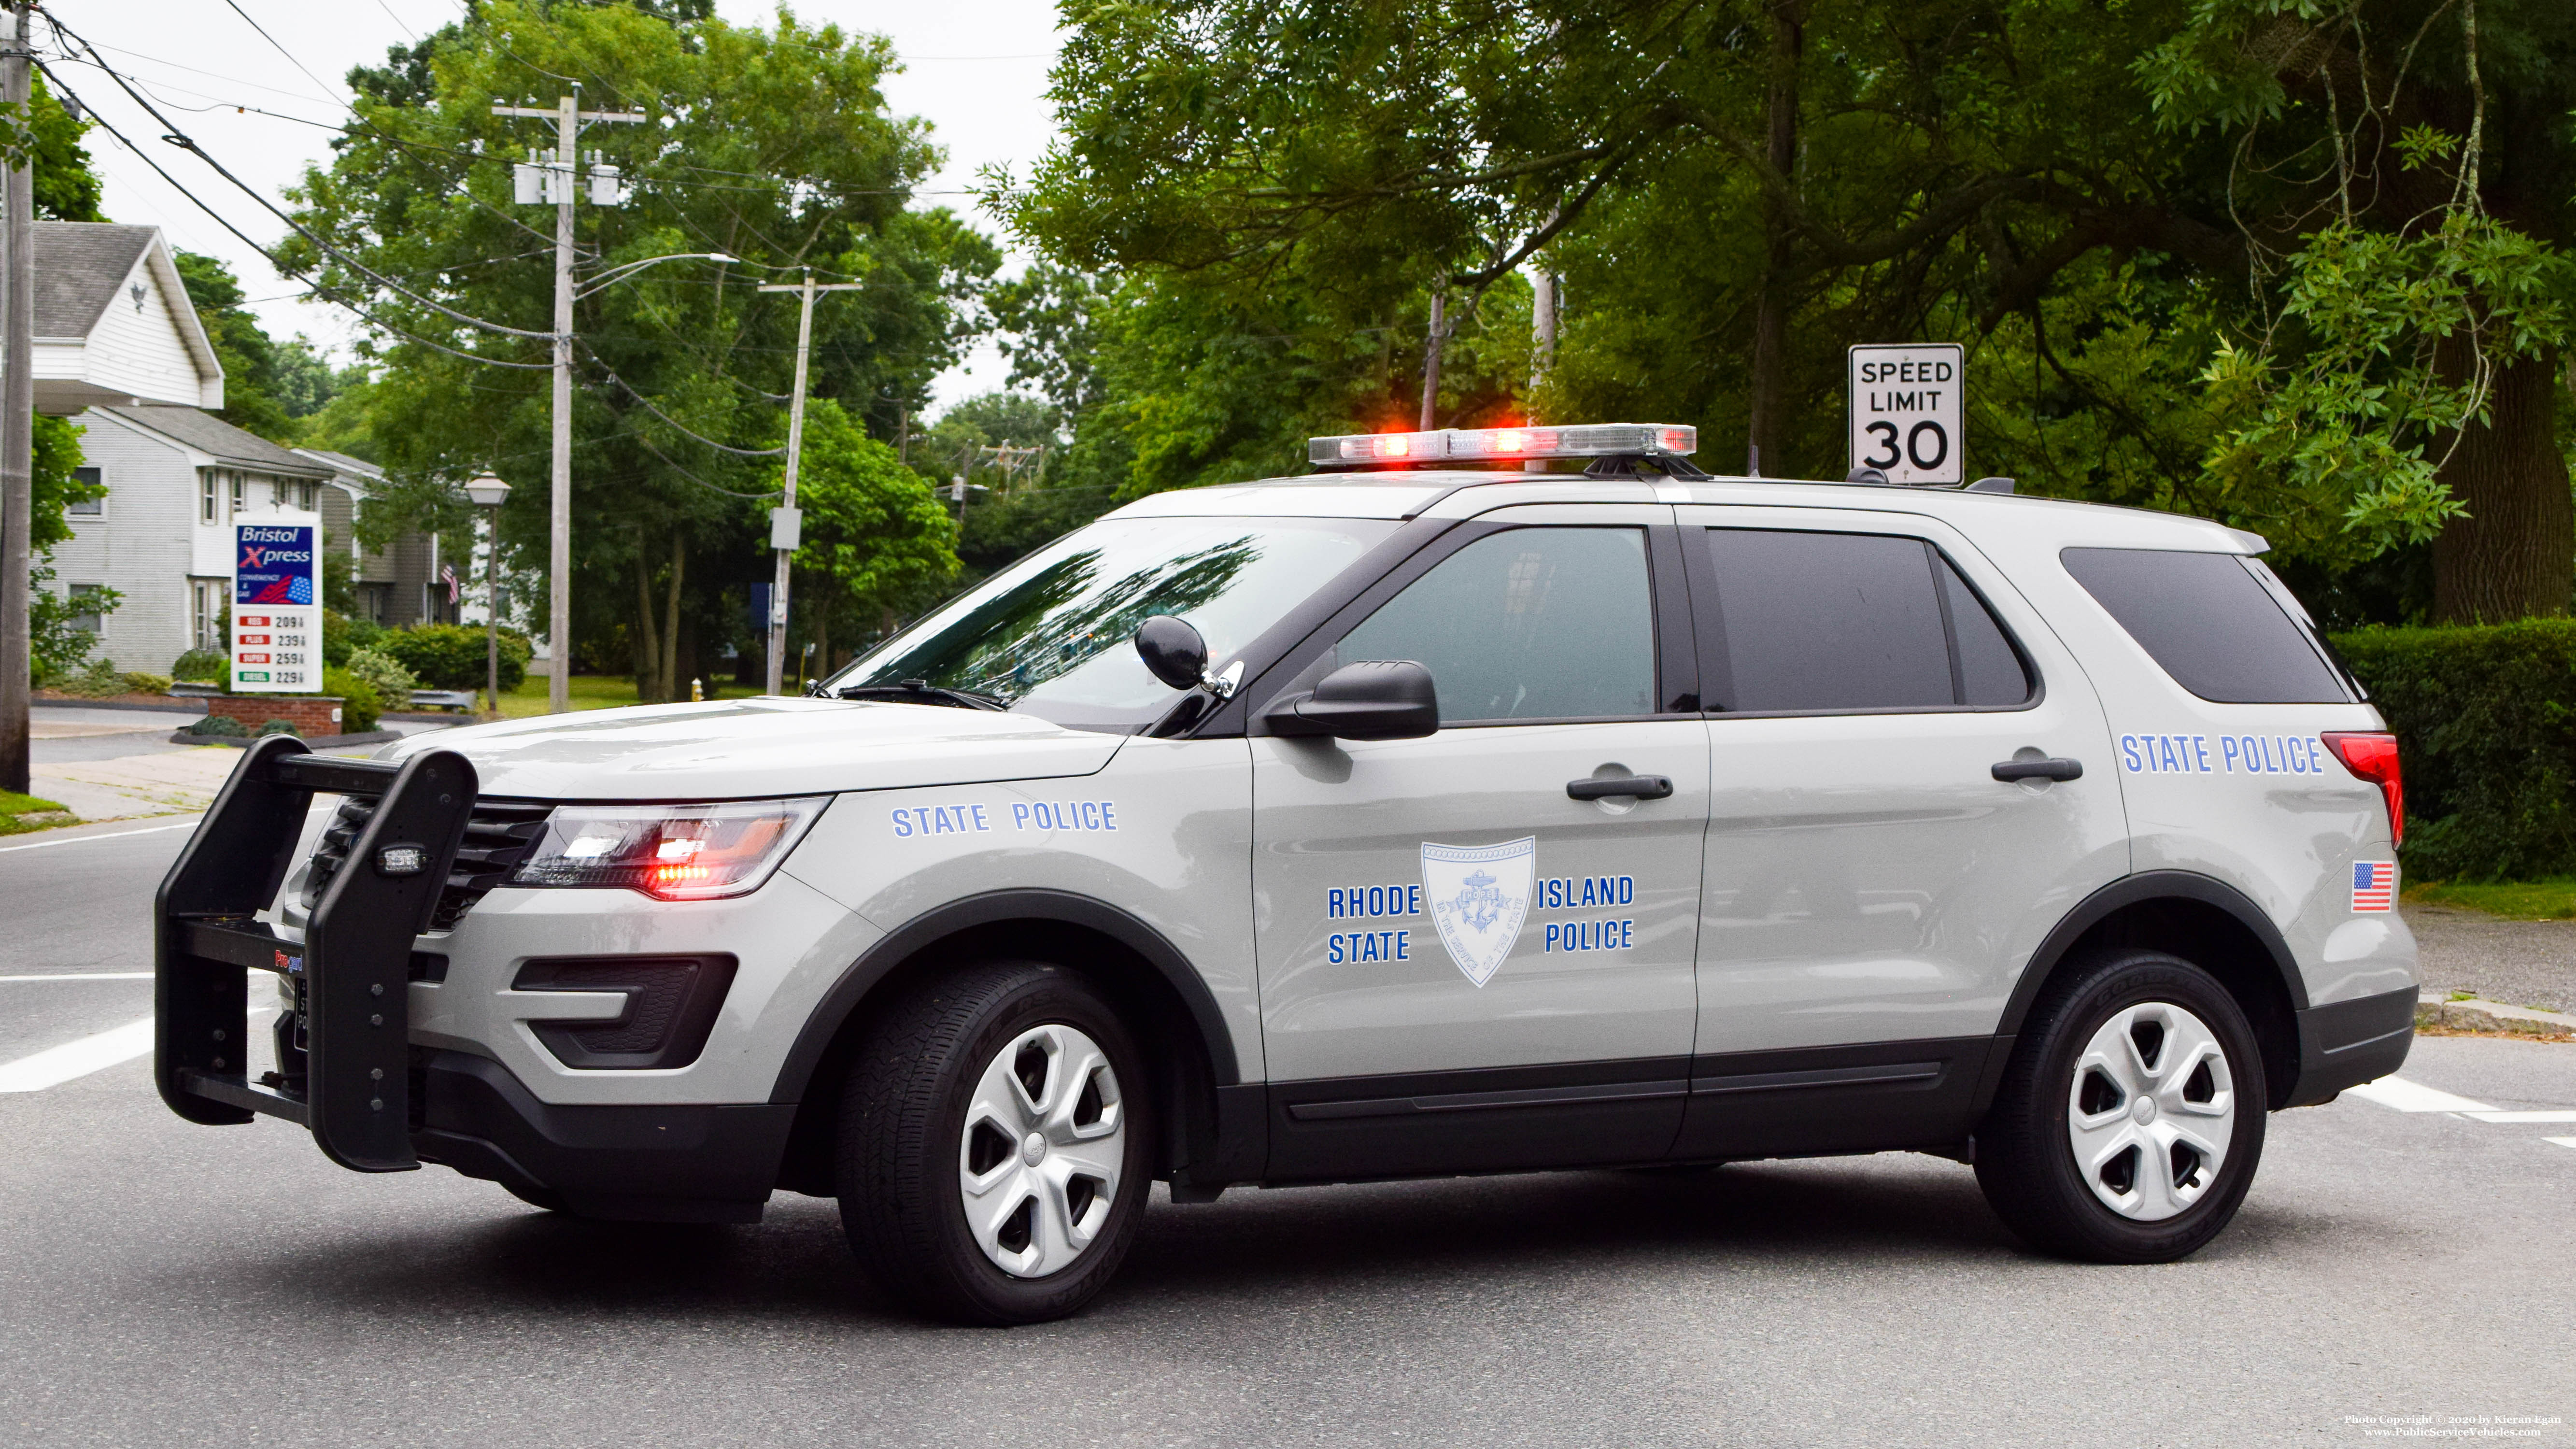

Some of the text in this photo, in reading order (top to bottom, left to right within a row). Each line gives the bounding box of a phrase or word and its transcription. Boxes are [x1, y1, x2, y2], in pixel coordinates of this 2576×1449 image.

[1862, 362, 1952, 383] SPEED
[1871, 391, 1941, 411] LIMIT
[1864, 420, 1948, 470] 30
[241, 526, 298, 542] Bristol
[238, 546, 311, 568] Xpress
[243, 654, 266, 662] SUPER
[2121, 734, 2323, 775] STATE POLICE
[892, 802, 1117, 837] STATE POLICE
[1328, 876, 1633, 919] RHODE ISLAND
[1467, 891, 1492, 899] HOPE
[1328, 920, 1633, 964] STATE POLICE
[1436, 897, 1523, 971] IN THE SERVICE OF THE STATE
